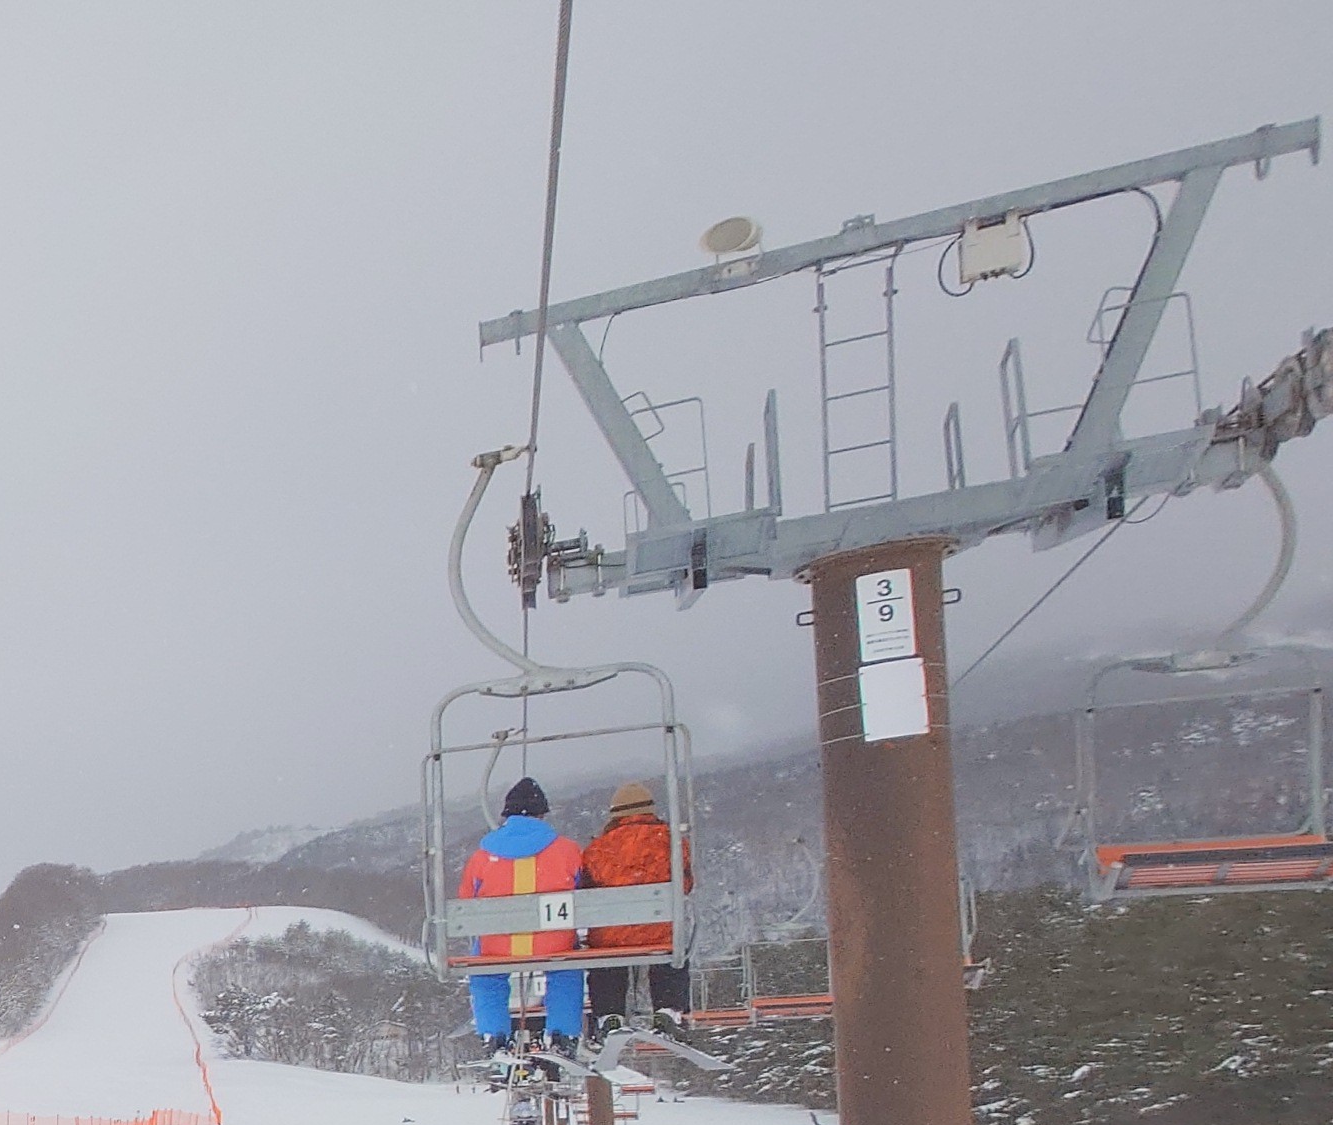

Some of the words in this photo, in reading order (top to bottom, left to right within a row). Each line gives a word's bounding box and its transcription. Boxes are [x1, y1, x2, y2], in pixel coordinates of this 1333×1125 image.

[877, 579, 892, 596] 3
[878, 604, 894, 622] 9
[545, 902, 569, 922] 14
